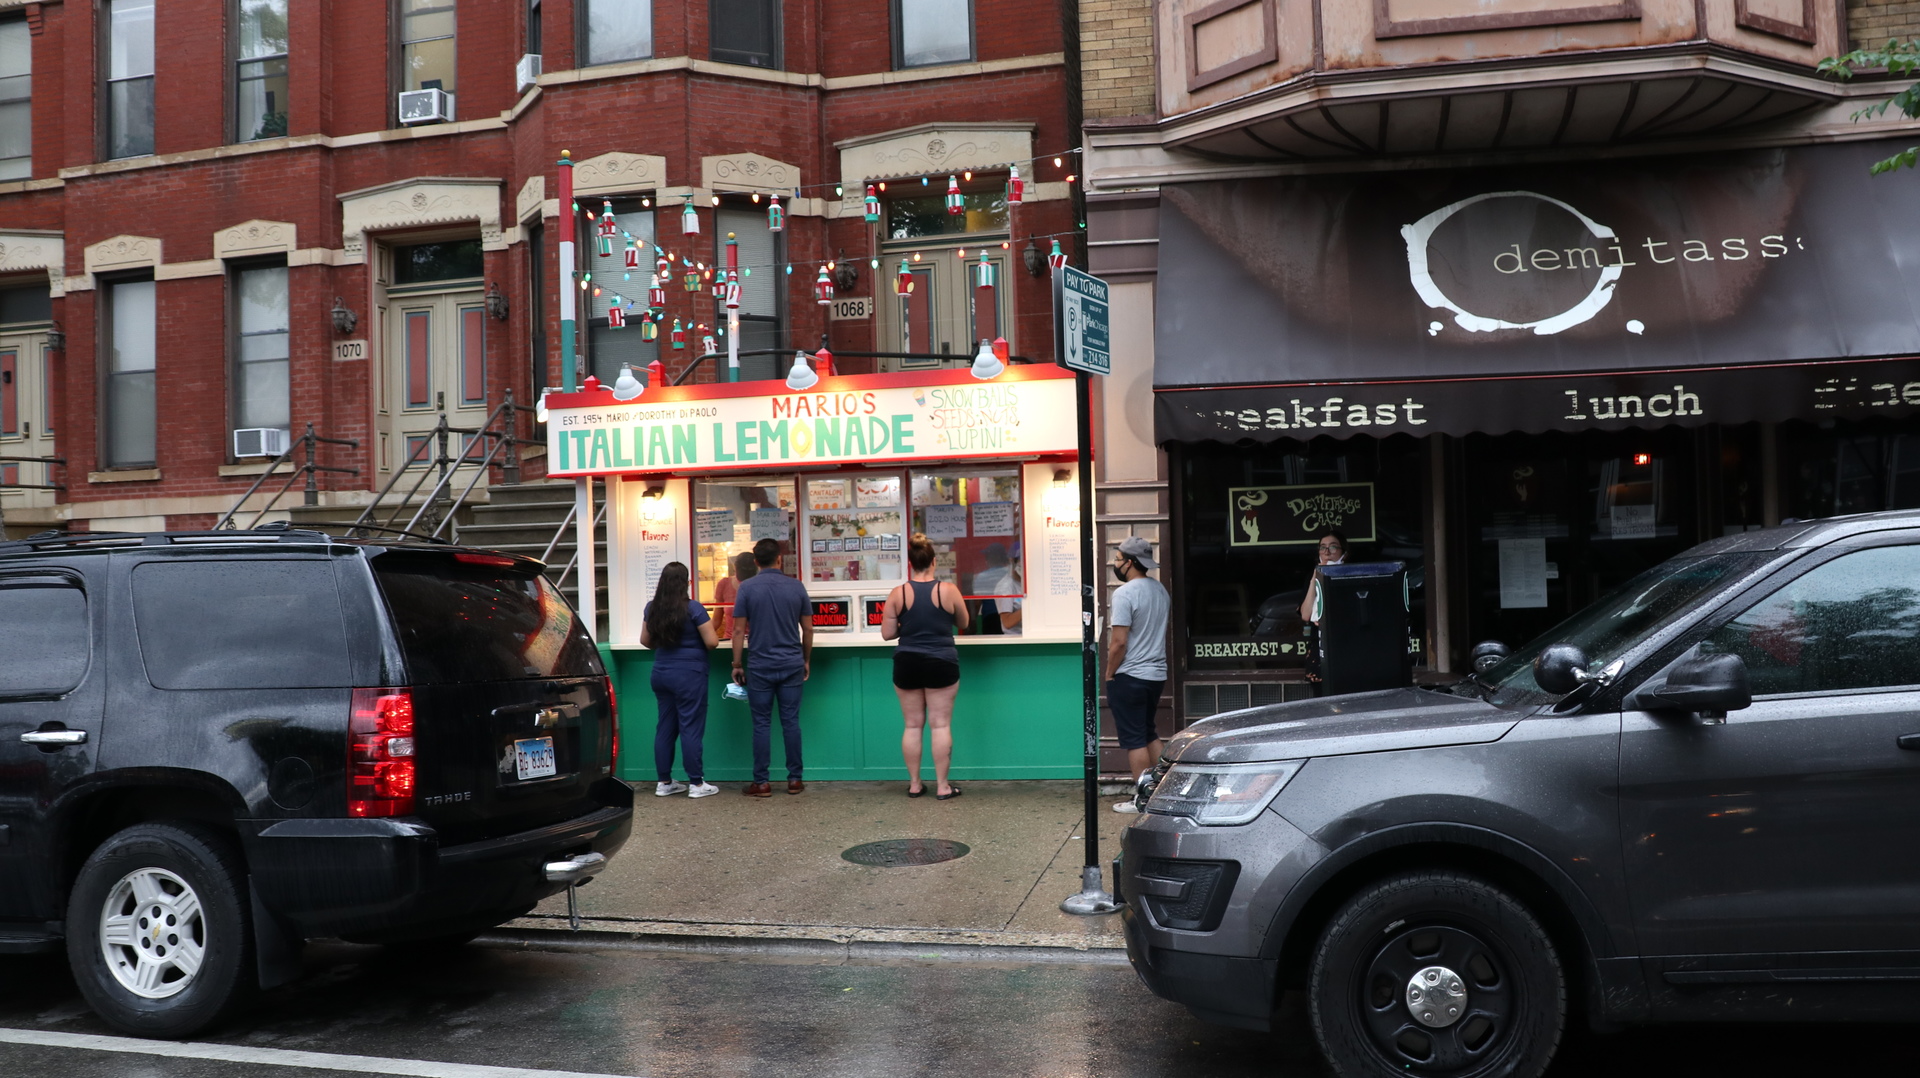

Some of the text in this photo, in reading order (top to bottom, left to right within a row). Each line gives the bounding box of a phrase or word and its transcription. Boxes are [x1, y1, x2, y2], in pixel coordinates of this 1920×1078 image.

[1493, 234, 1805, 275] demitass
[1066, 272, 1106, 300] PAY TO PARK
[833, 301, 865, 317] 1068
[336, 343, 362, 358] 1070
[772, 391, 876, 419] MARIO'S
[1564, 385, 1703, 420] lunch
[562, 415, 580, 426] EST.
[583, 413, 602, 425] 1954
[932, 408, 976, 429] SEEDS
[1184, 397, 1428, 430] eakfast
[558, 414, 915, 470] ITALIAN LEMONADE
[946, 426, 1003, 450] LUPINI
[751, 519, 769, 528] 2020
[928, 515, 949, 523] 2020
[1046, 516, 1081, 528] Flavors
[641, 530, 670, 542] Flavors
[819, 602, 839, 614] NO
[875, 602, 885, 612] N
[812, 613, 847, 625] SMOKING
[1194, 641, 1278, 658] BREAKFAST
[531, 748, 553, 769] 83629
[424, 791, 472, 807] TAHOE
